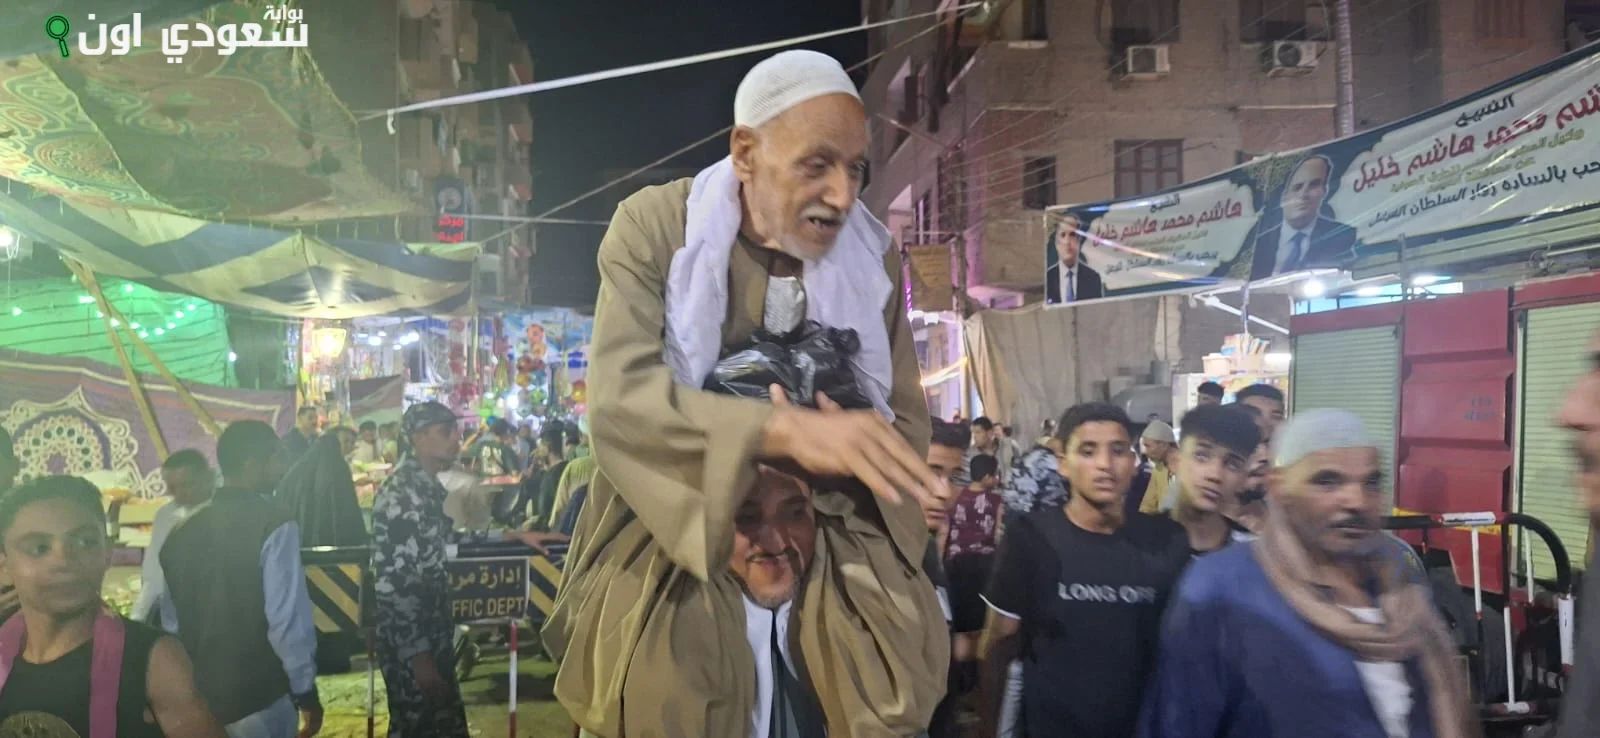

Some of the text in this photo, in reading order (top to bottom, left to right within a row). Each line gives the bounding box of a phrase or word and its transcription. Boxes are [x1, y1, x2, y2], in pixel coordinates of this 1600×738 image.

[1455, 93, 1516, 128] الشيخ
[1555, 84, 1600, 130] شم
[1482, 112, 1548, 149] محمد
[1406, 133, 1476, 176] هاشم
[1352, 154, 1401, 193] خليل
[1196, 198, 1242, 229] هاشم
[1409, 187, 1468, 217] السلطان
[1120, 214, 1158, 241] هاشم
[1160, 214, 1194, 231] محمد
[480, 564, 522, 591] إدارة
[1058, 581, 1118, 603] LONG
[452, 596, 524, 617] FFIC DEPT
